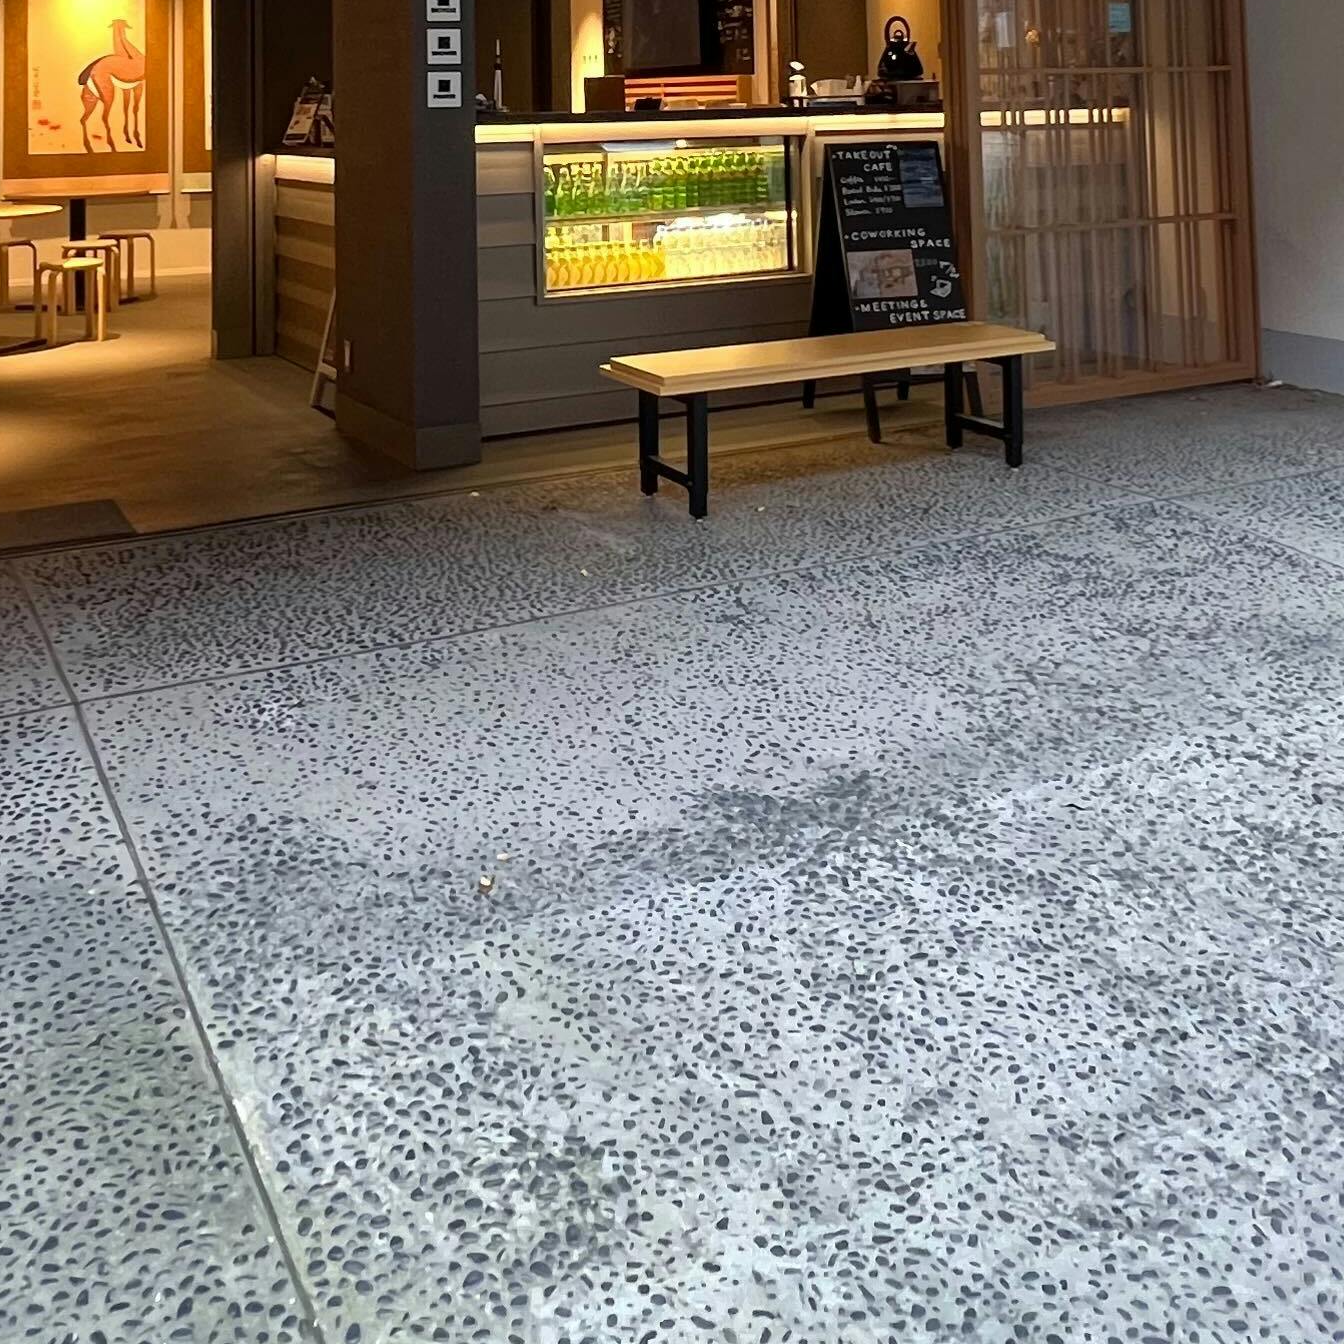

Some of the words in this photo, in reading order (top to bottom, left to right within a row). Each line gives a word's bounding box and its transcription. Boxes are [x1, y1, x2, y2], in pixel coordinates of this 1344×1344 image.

[863, 162, 893, 172] CAFE
[850, 227, 927, 241] COWORKING
[910, 238, 951, 249] SPACE
[889, 310, 930, 324] EVENT
[933, 309, 967, 321] SPACE
